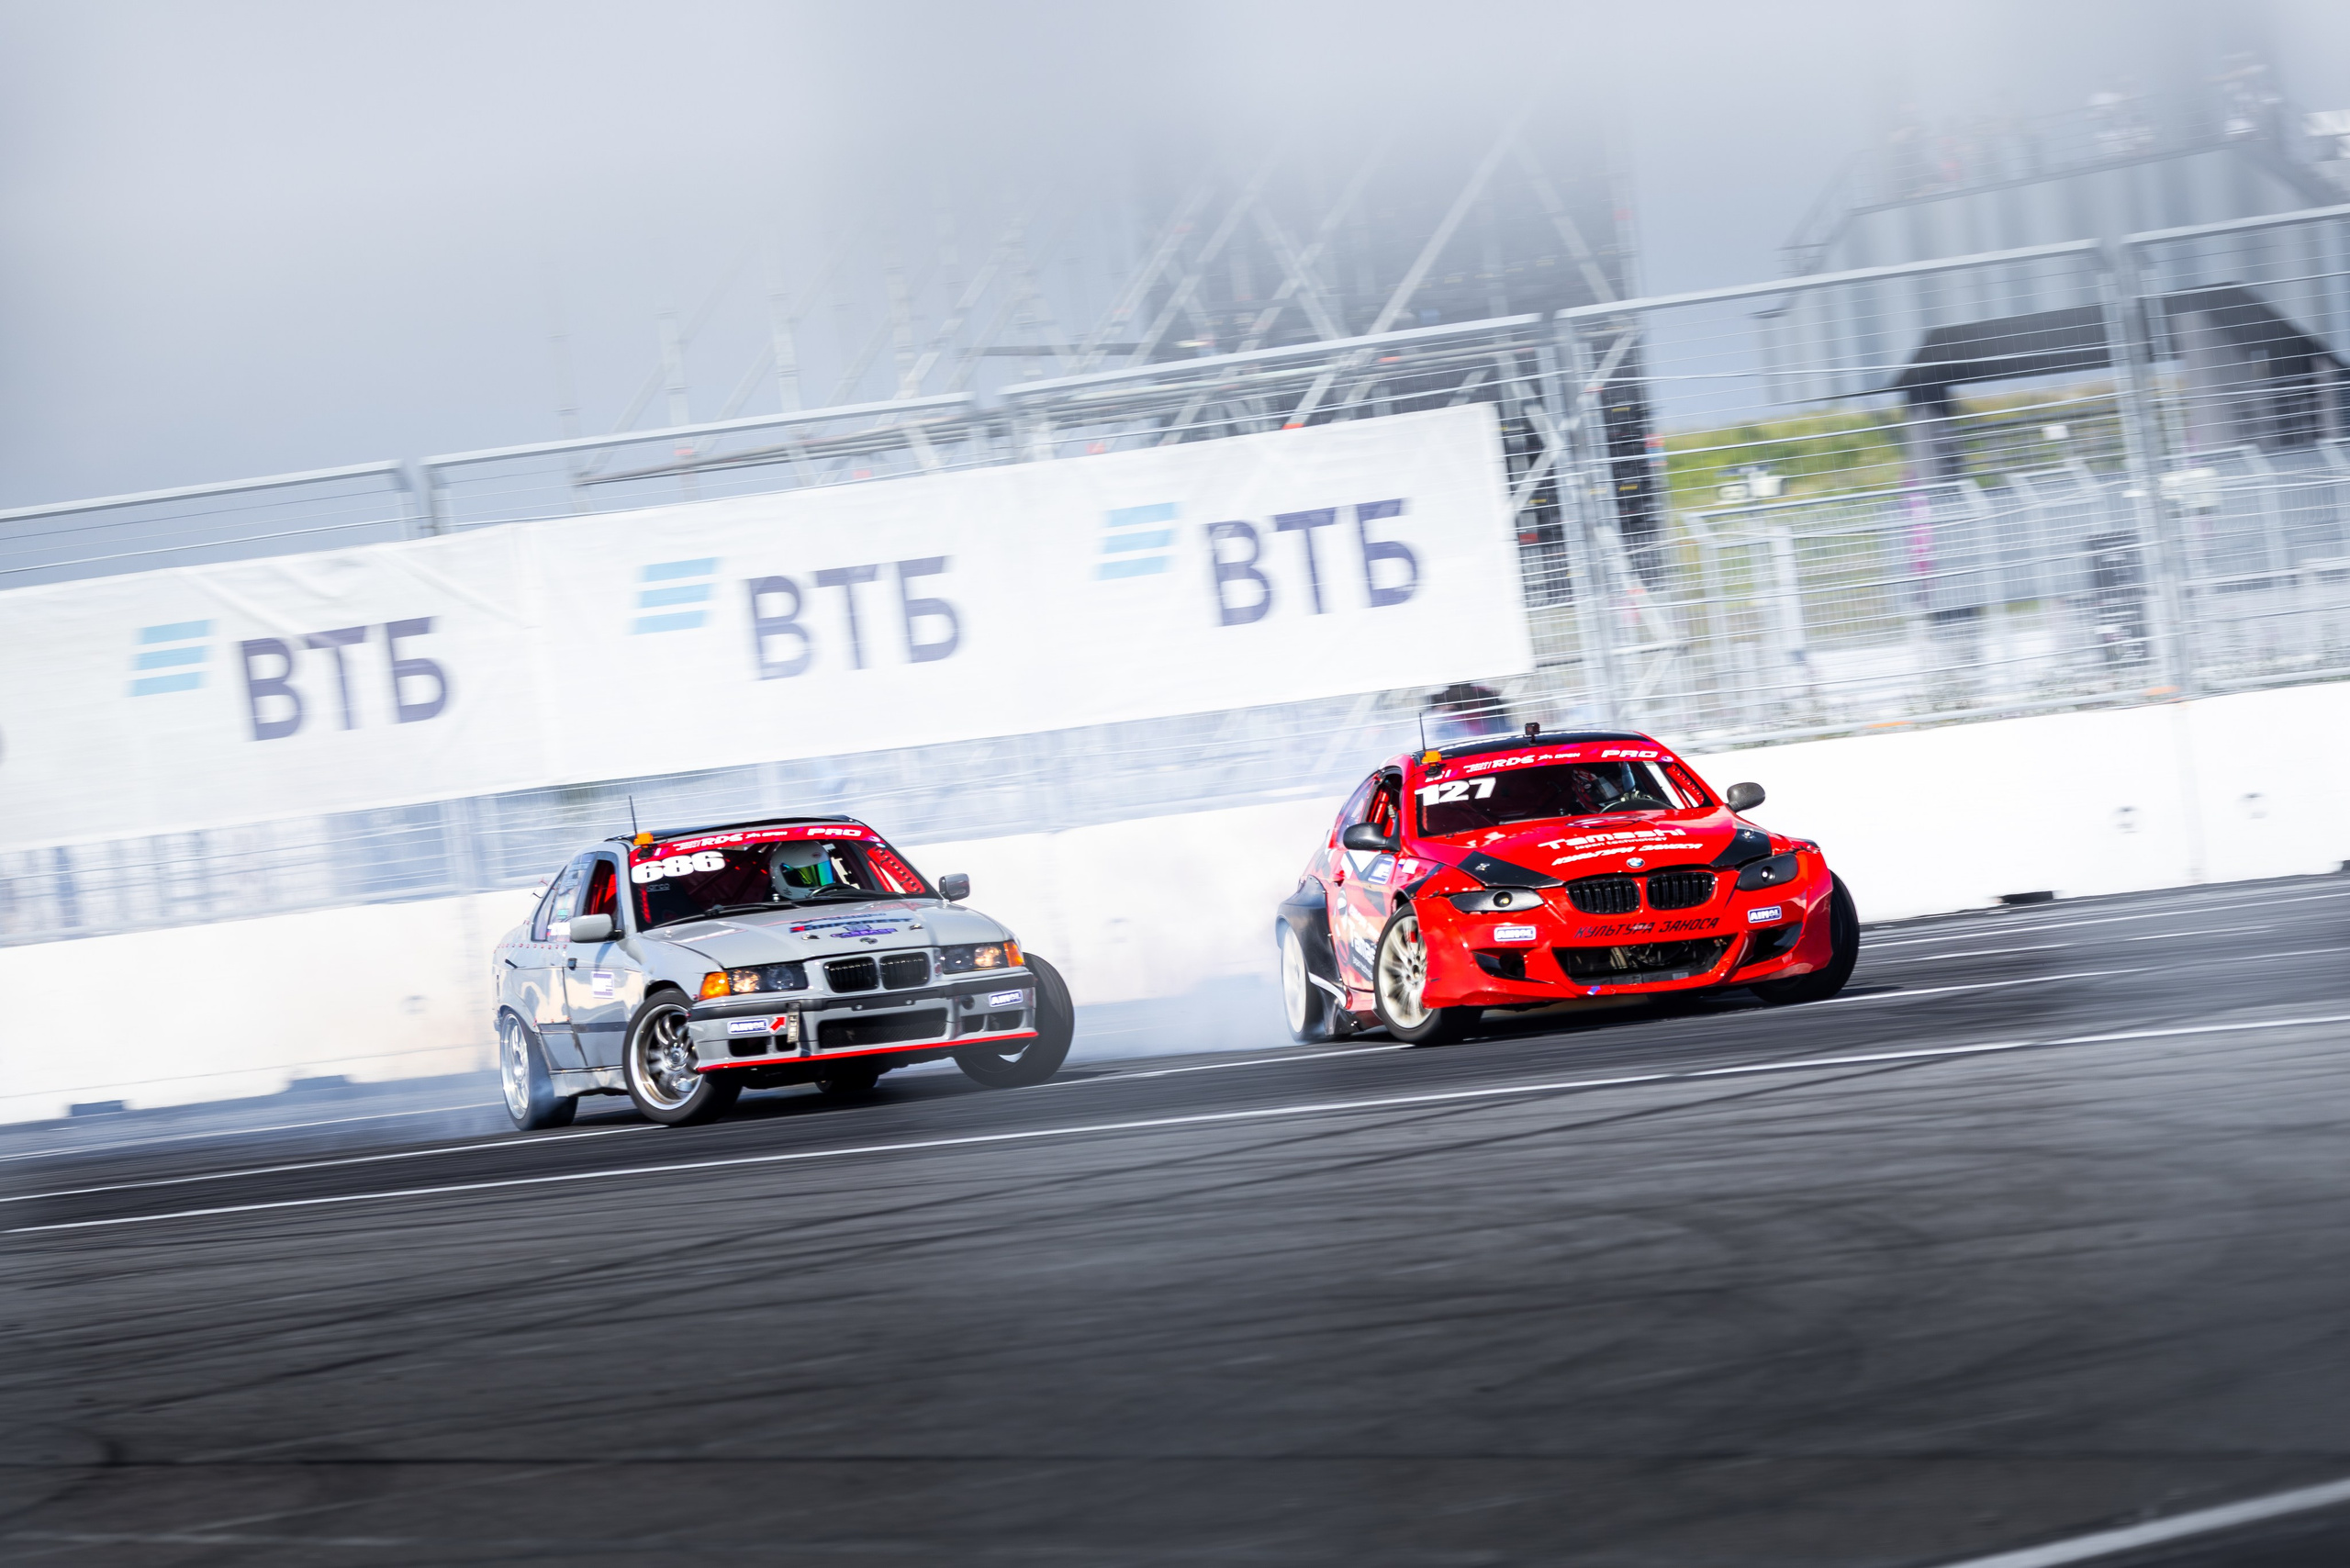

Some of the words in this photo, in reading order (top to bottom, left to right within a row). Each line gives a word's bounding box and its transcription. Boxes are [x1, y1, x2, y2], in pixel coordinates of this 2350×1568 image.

[1203, 498, 1421, 626] ВТБ
[744, 555, 962, 680] ВТБ
[239, 616, 450, 741] ВТБ
[1601, 749, 1659, 758] PRO
[1415, 777, 1496, 806] 127
[807, 827, 862, 837] PRO
[1538, 828, 1687, 850] Tamashi
[631, 850, 726, 884] 686
[1574, 922, 1655, 938] КУЛЬТУРА
[1658, 917, 1720, 933] ЗАНОСА
